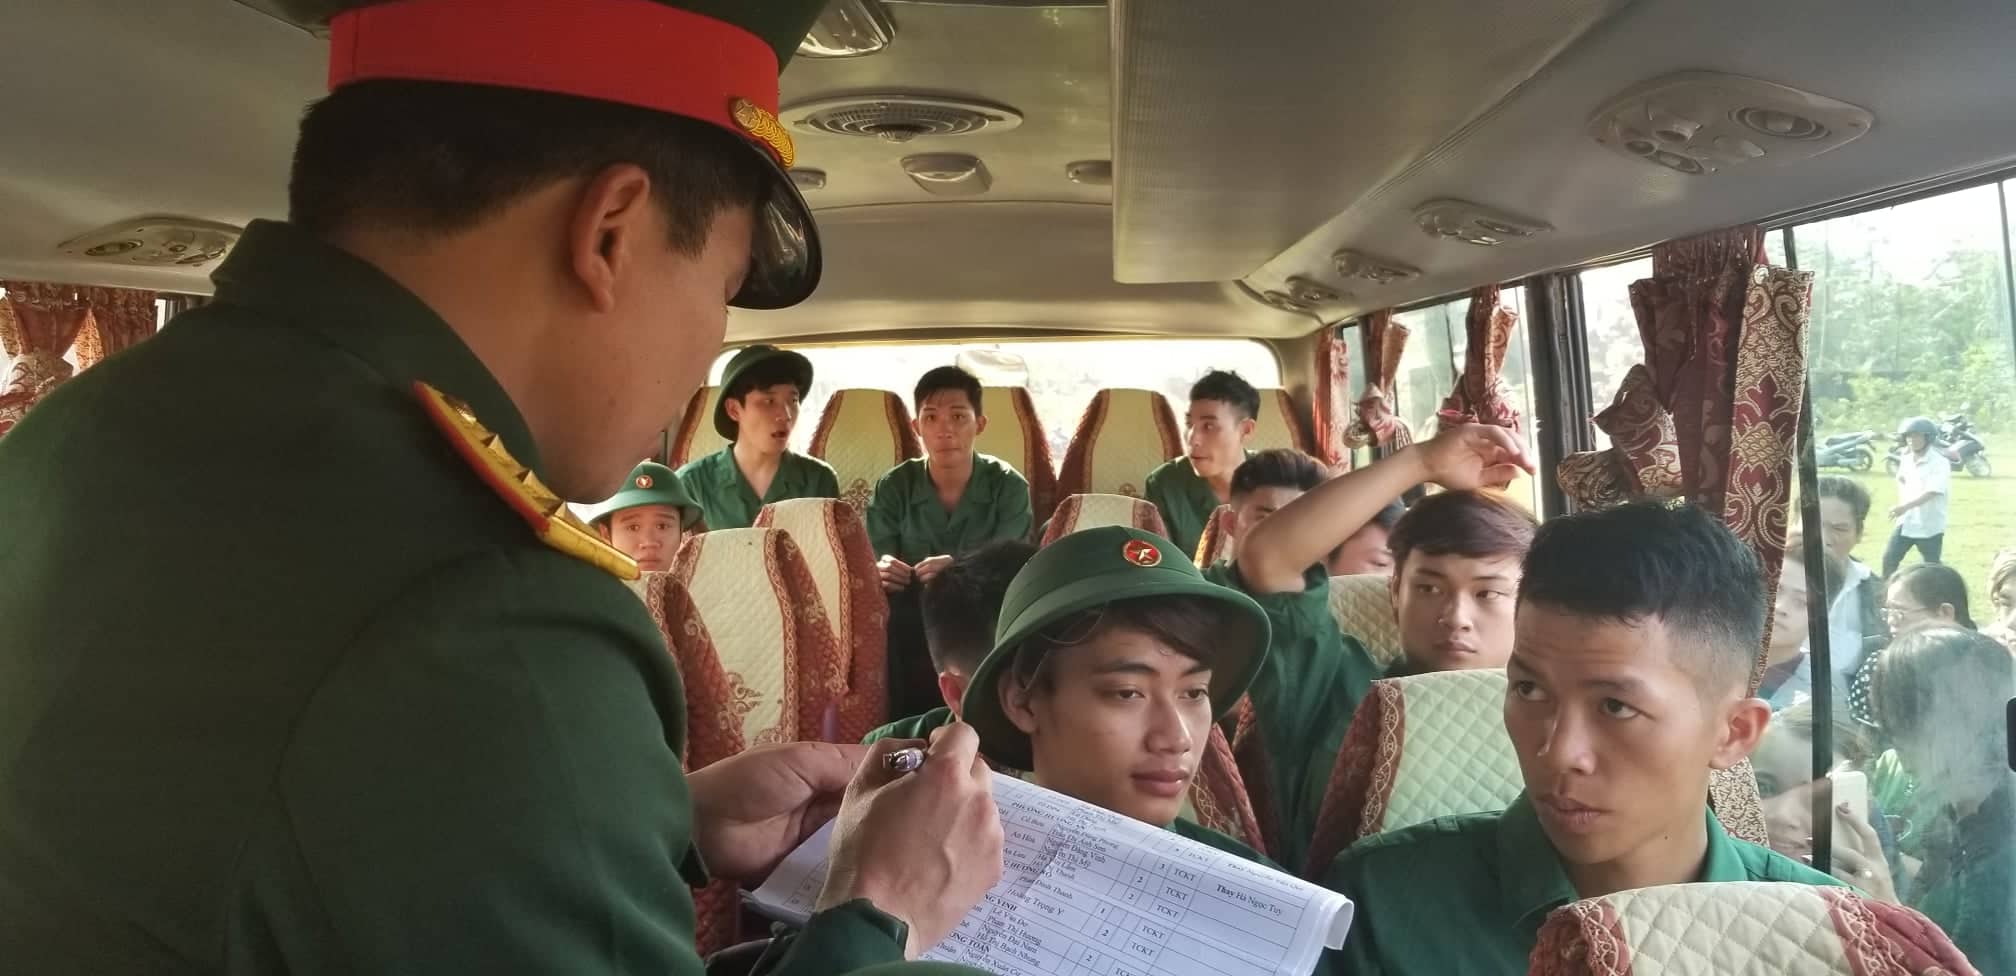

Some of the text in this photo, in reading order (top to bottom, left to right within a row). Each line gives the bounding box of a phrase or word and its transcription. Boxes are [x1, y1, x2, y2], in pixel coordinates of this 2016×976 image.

[1174, 868, 1196, 883] TCKT
[1166, 886, 1188, 901] TCKT
[996, 897, 1018, 912] VINH
[1157, 904, 1179, 919] TCKT
[1102, 929, 1109, 937] 2
[1142, 924, 1166, 940] TCKT
[1131, 942, 1155, 957] TCKT
